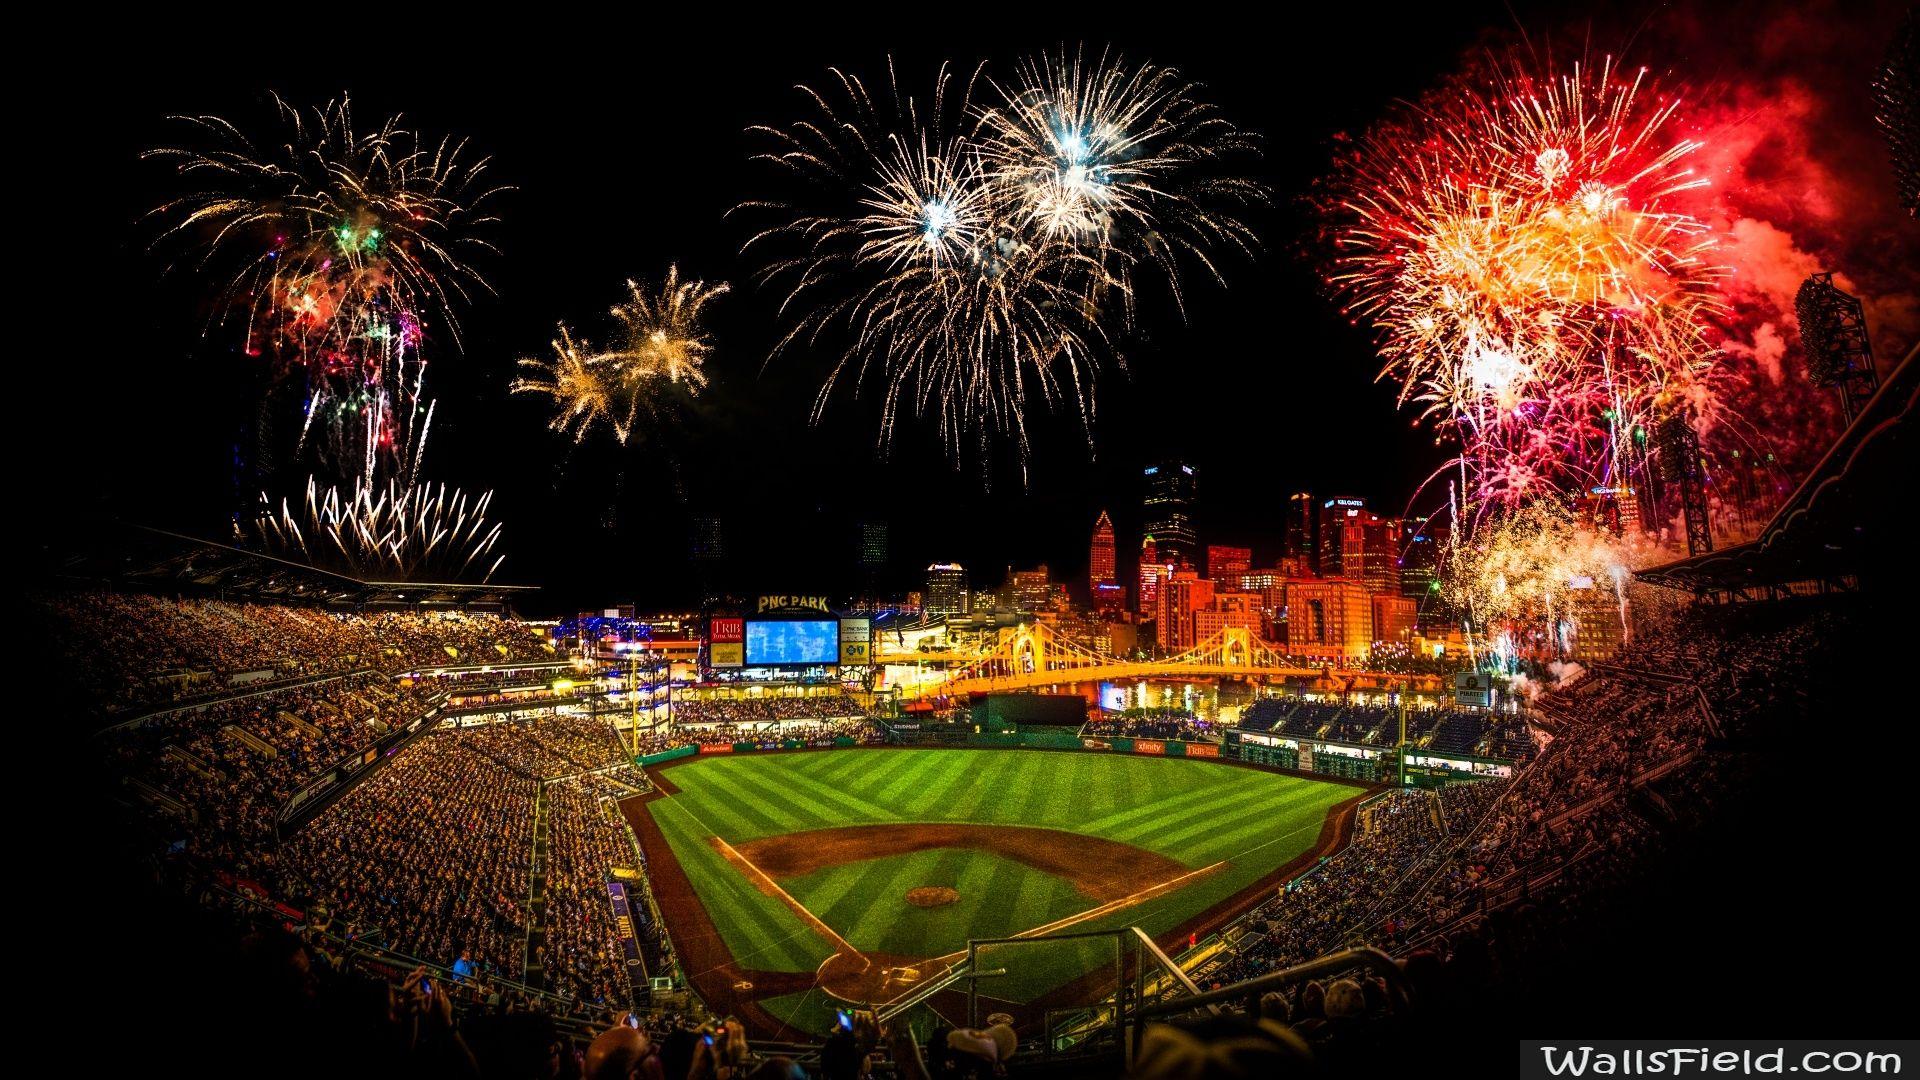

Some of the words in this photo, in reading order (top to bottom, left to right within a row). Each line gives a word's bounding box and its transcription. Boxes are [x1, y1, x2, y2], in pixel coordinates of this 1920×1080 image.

[758, 595, 788, 614] PNC
[791, 595, 830, 613] PARK
[713, 621, 740, 633] TRIB
[1139, 742, 1161, 752] xfinity
